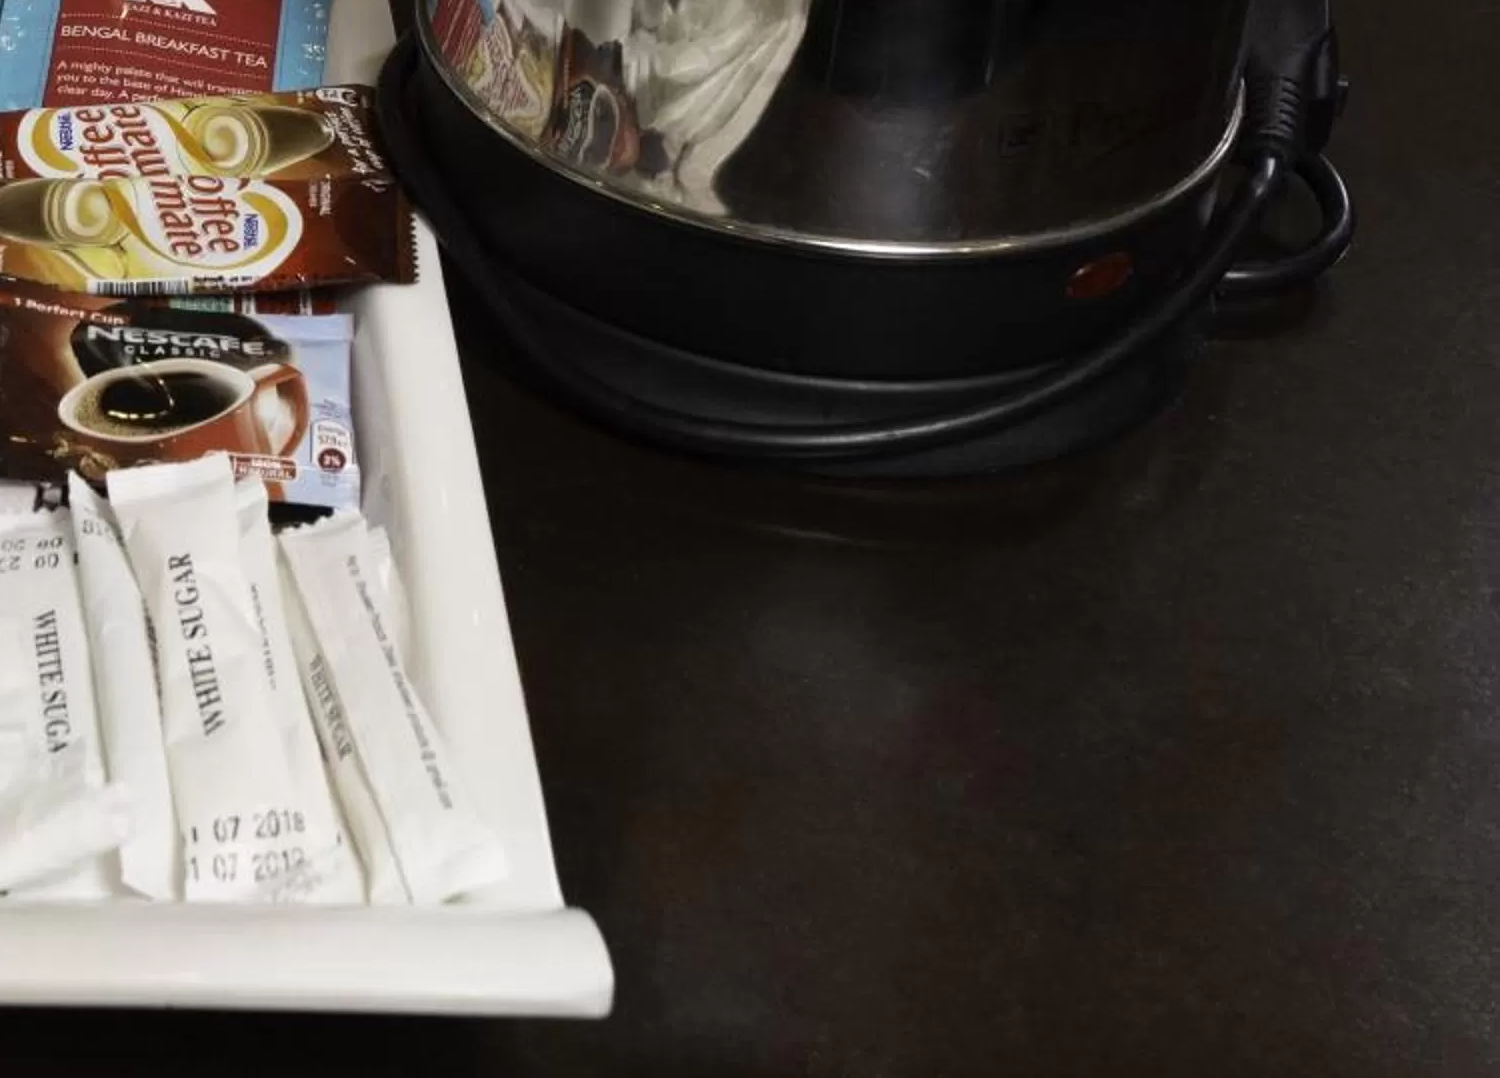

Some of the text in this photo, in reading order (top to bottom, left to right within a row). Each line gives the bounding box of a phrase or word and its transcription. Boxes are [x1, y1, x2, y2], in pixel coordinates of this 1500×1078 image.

[124, 3, 150, 16] AZI
[60, 25, 268, 69] BENGAL BREAKFAST TEA
[57, 60, 67, 71] A
[71, 61, 113, 76] mighty
[56, 73, 80, 85] you
[83, 73, 98, 84] to
[99, 74, 120, 87] the
[153, 81, 169, 93] of
[56, 85, 88, 97] clear
[149, 179, 203, 257] mate
[25, 300, 85, 319] Perfect
[90, 312, 124, 326] Cup
[123, 344, 222, 360] CLASSIC
[33, 609, 64, 687] WHITE
[168, 553, 226, 737] WHITE SUGAR
[212, 815, 241, 843] 07
[212, 853, 238, 882] 07
